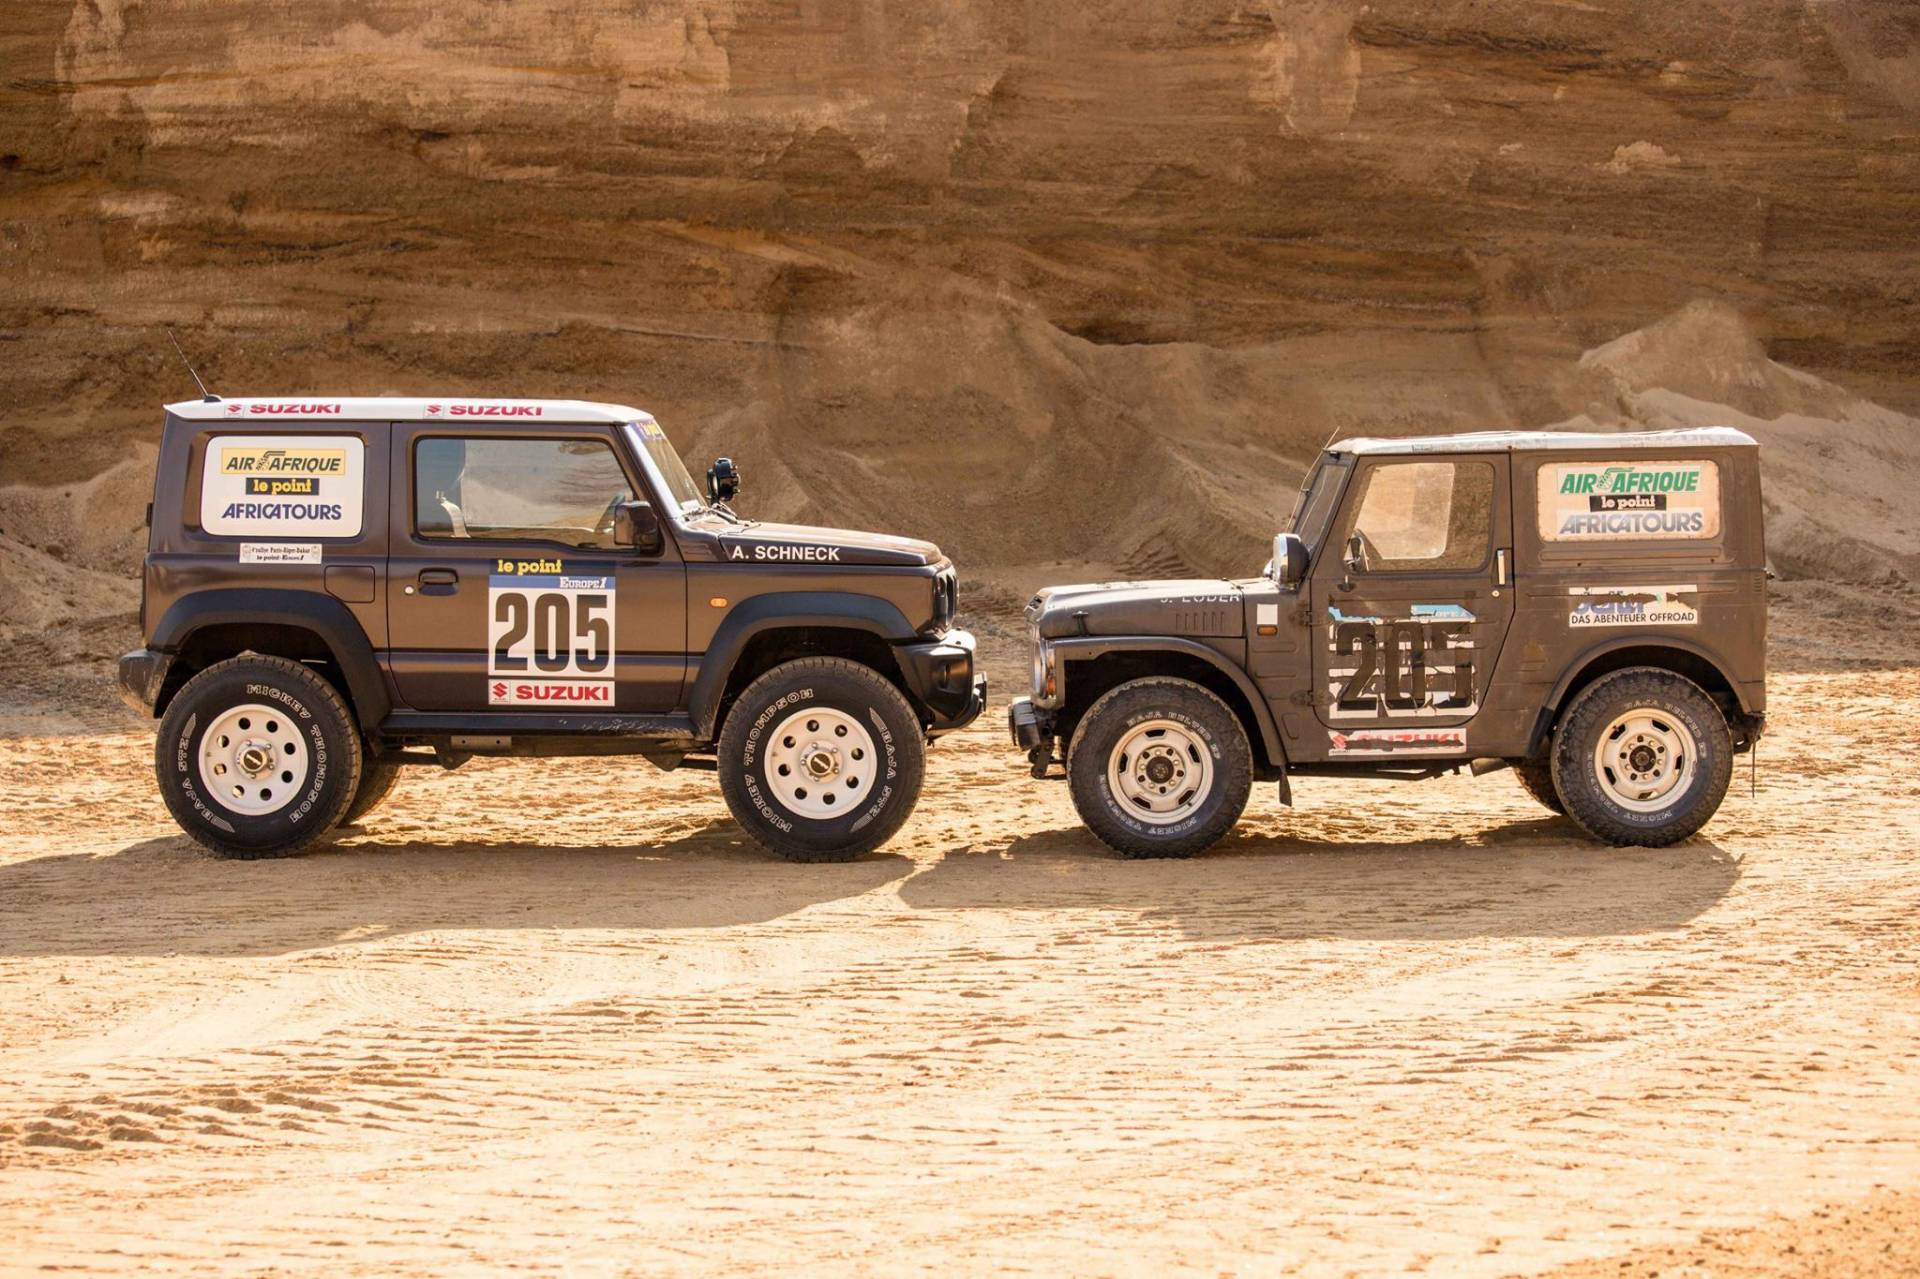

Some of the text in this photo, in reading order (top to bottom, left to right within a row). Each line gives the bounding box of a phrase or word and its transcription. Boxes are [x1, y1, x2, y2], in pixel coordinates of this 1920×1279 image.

[250, 404, 342, 414] SUZUKI
[450, 405, 543, 416] SUZUKI
[226, 456, 341, 473] AIR AFRIQUE
[253, 478, 312, 495] le point
[1560, 471, 1700, 494] AIR AFRIQUE
[1601, 495, 1656, 510] le point
[222, 503, 342, 520] AFRICATOURS
[1560, 512, 1703, 534] AFRICATOURS
[732, 546, 840, 561] A. SCHNECK
[497, 559, 562, 576] le point
[1572, 612, 1695, 624] DAS ABENTEUER OFFROAD
[495, 592, 609, 672] 205
[1336, 622, 1473, 711] 205
[516, 685, 608, 701] SUZUKI
[246, 684, 327, 823] MICKEY THOMPSON
[744, 688, 814, 833] MICKEY THOMPSON
[882, 728, 897, 779] BAJA
[182, 777, 213, 822] BAJA
